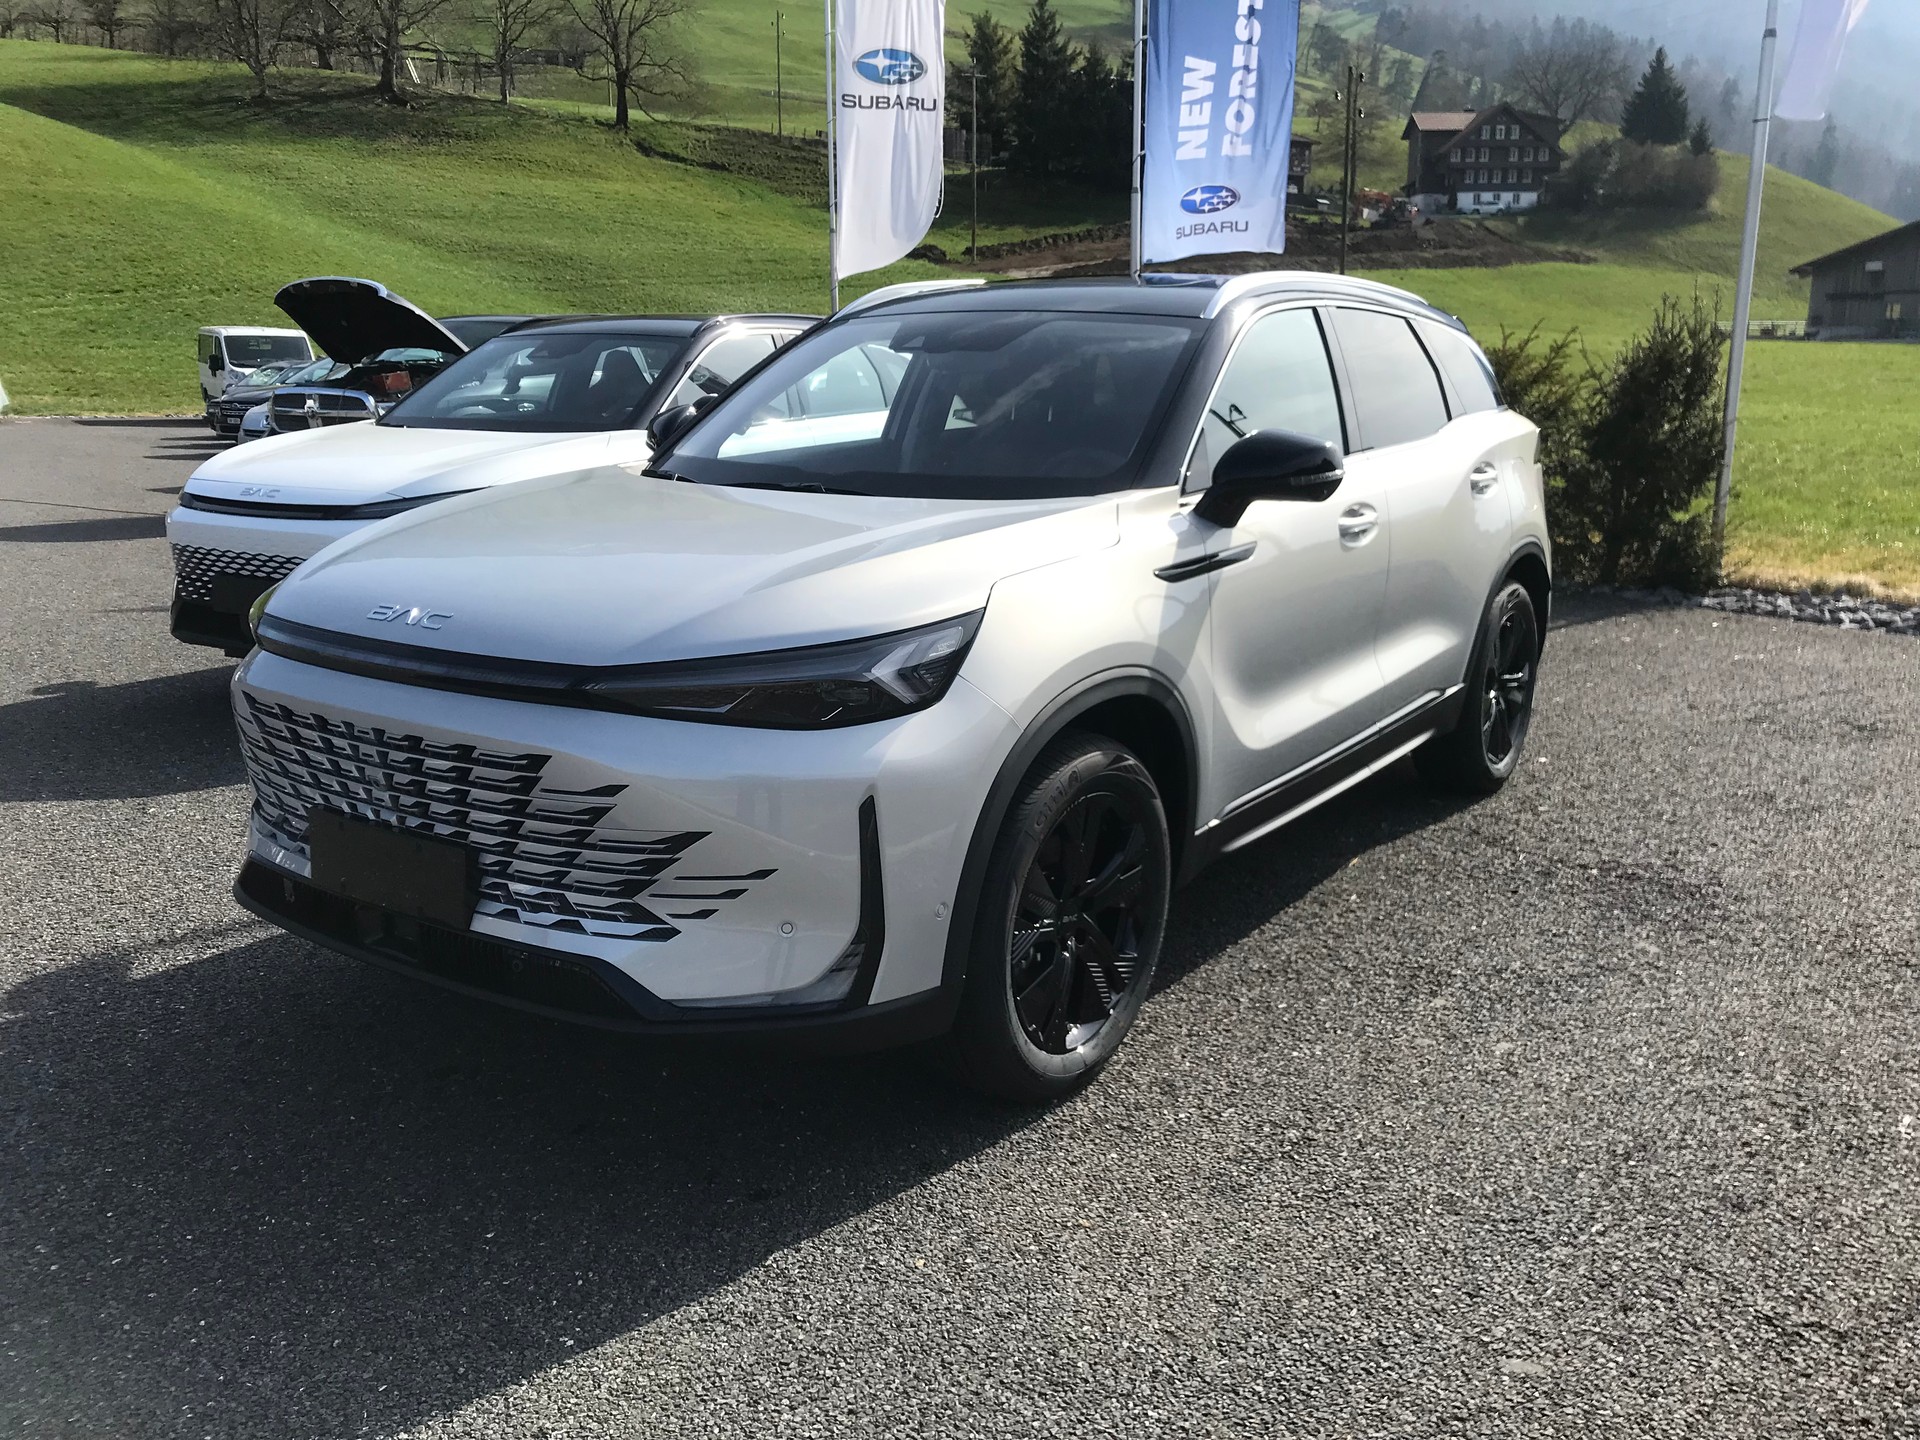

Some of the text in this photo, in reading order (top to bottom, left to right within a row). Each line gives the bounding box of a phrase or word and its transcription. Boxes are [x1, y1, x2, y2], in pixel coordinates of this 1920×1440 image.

[841, 93, 937, 112] SUBARU
[1175, 55, 1217, 161] NEW
[1176, 220, 1249, 240] SUBARU
[366, 604, 454, 631] BAIC
